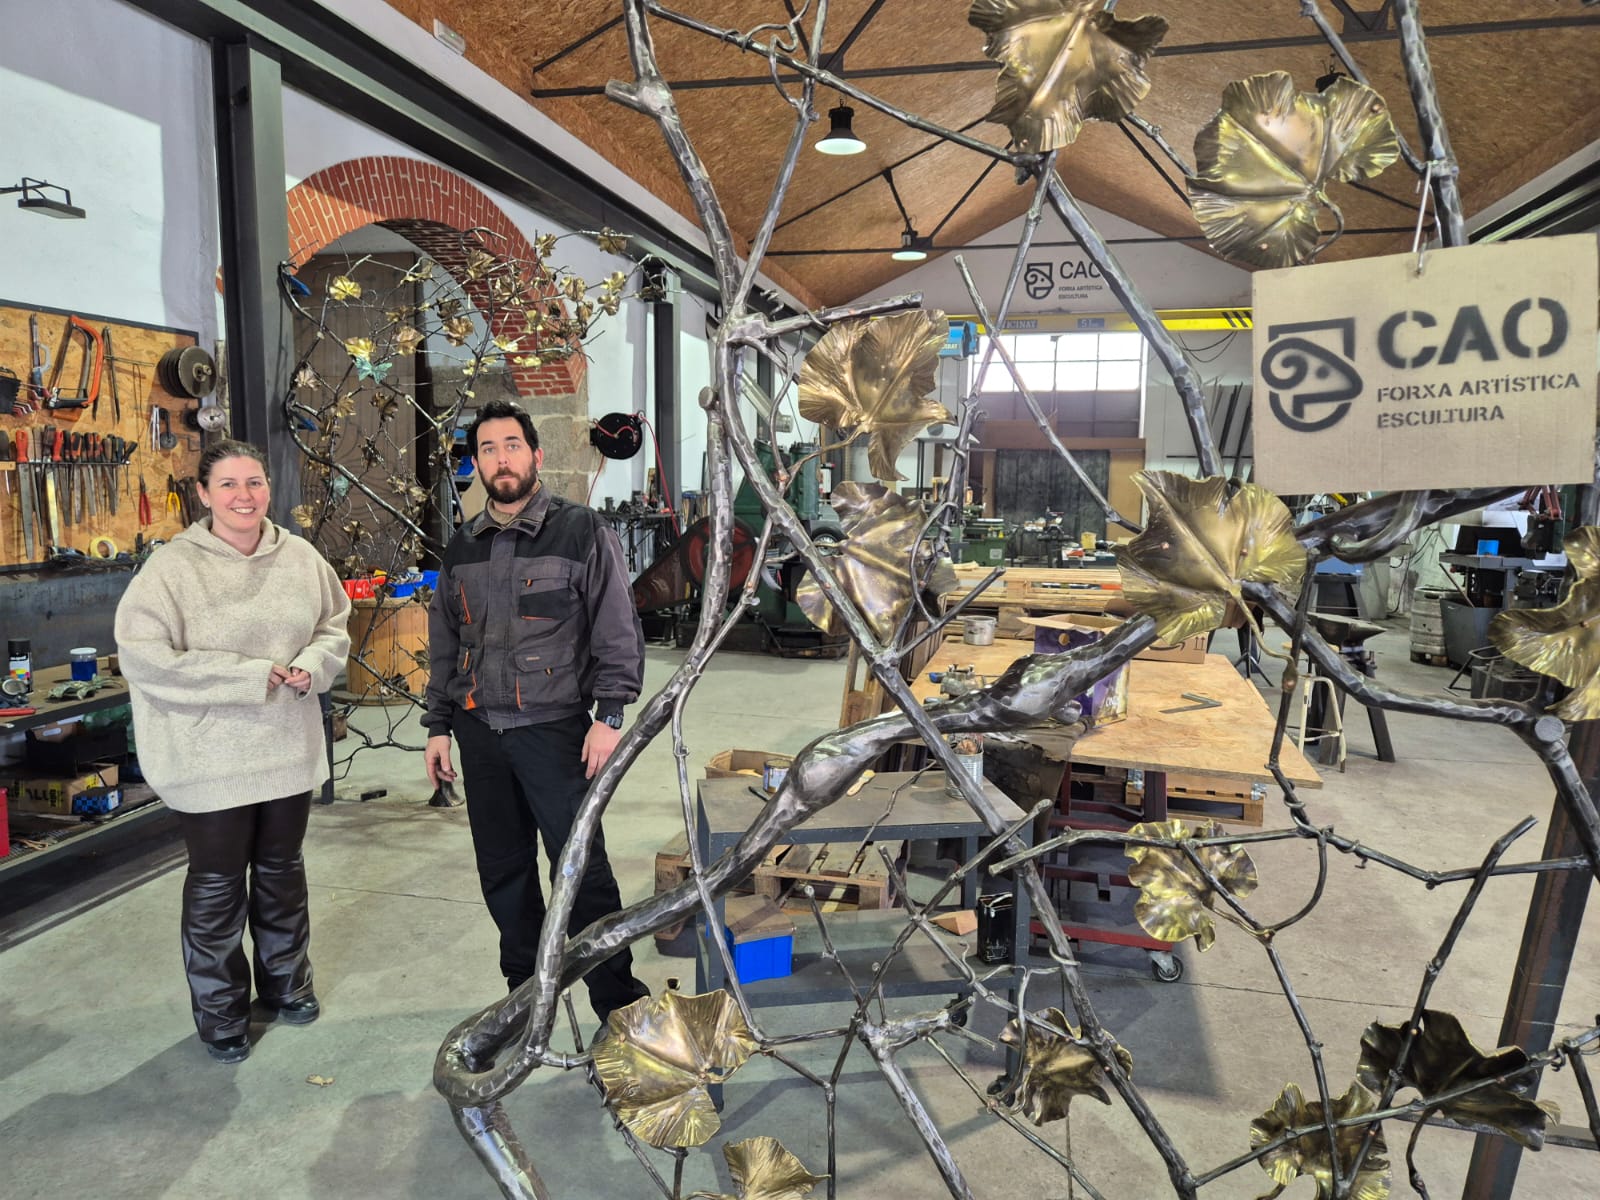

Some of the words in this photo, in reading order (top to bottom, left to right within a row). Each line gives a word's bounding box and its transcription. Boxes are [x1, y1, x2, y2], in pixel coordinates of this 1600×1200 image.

[1377, 297, 1569, 370] CAO
[1377, 383, 1453, 402] FORXA
[1459, 372, 1581, 396] ARTÍSTICA
[1377, 405, 1505, 429] ESCULTURA
